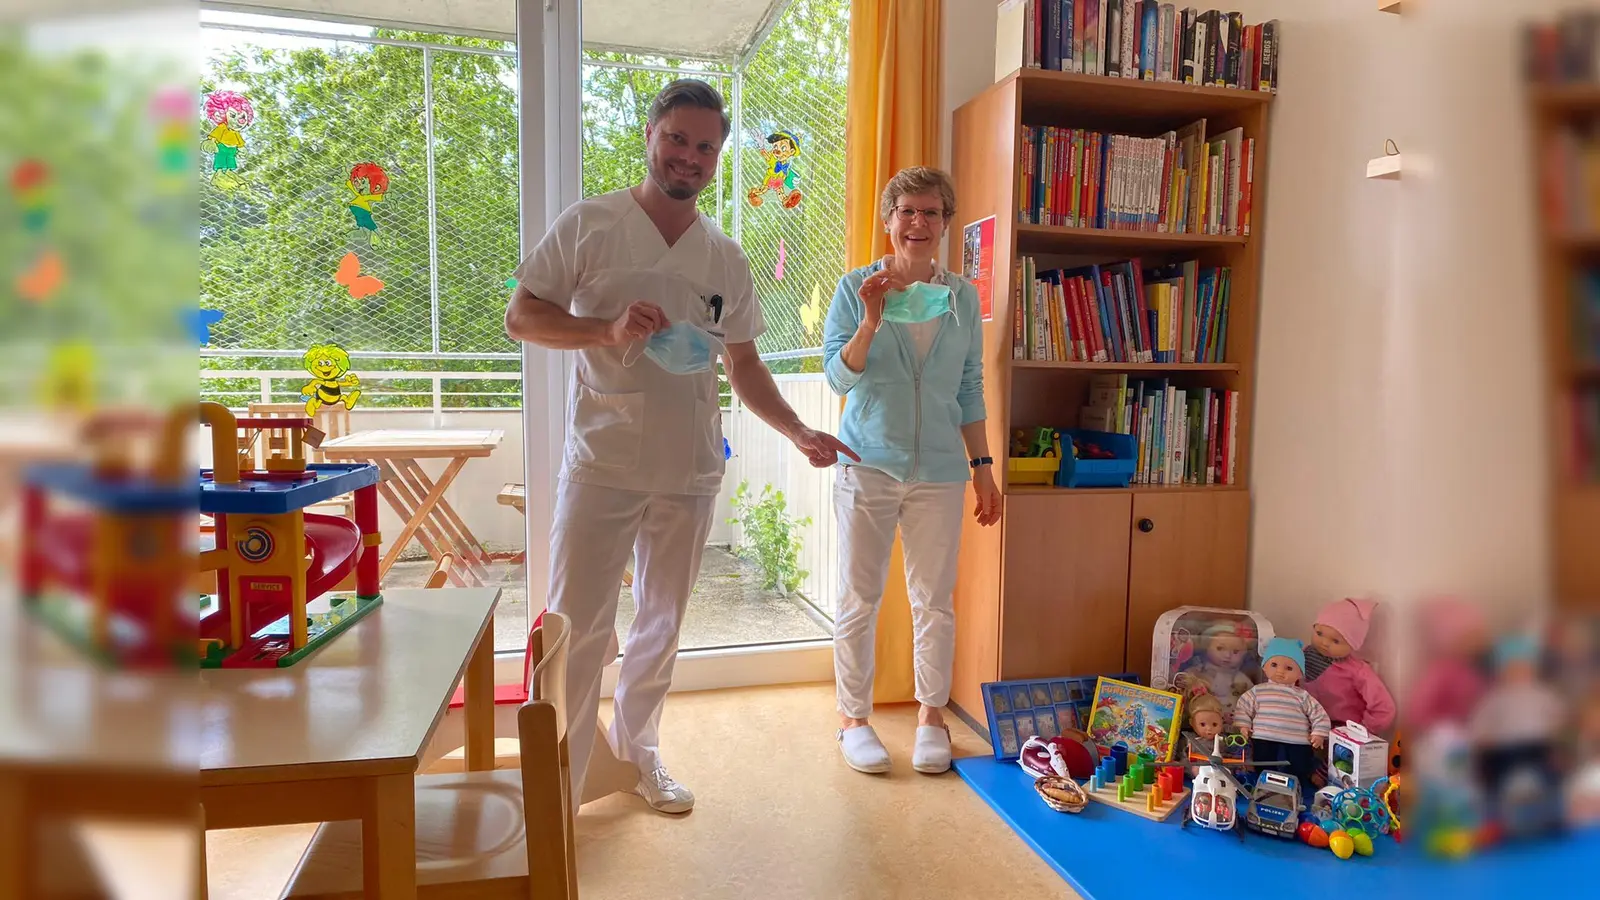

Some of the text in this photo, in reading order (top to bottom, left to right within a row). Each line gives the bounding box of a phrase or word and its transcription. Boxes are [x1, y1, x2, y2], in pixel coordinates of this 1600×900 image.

[1262, 39, 1271, 65] EREBOS
[252, 583, 280, 591] SERVICE
[1260, 807, 1285, 816] POLIZEI
